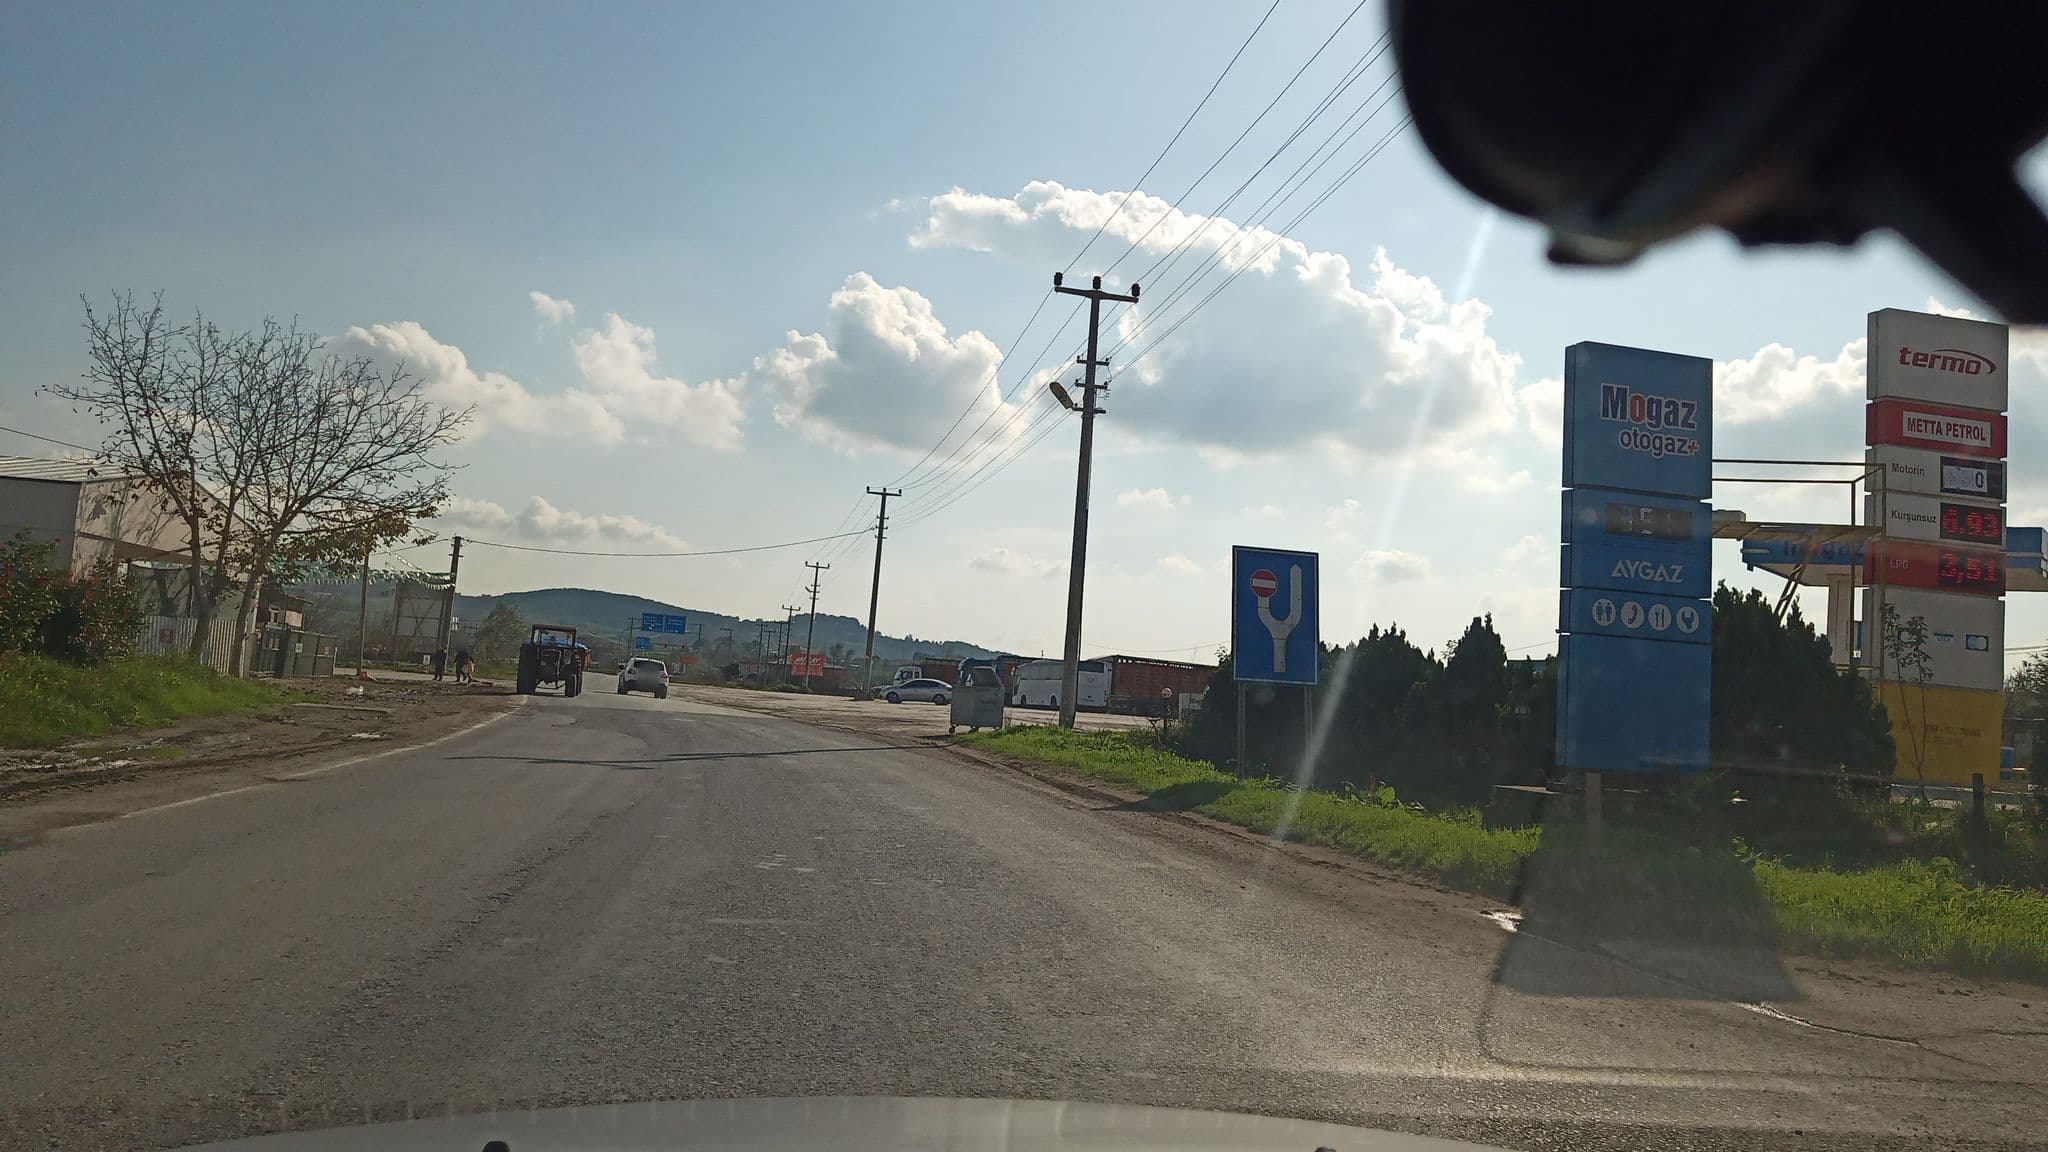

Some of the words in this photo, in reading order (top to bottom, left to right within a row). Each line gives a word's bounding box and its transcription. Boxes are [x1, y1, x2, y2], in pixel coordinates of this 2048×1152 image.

[1899, 347, 1982, 376] termo
[1601, 383, 1697, 429] Mogaz
[1906, 416, 1943, 435] METTA
[1945, 423, 1986, 441] PETROL
[1892, 462, 1925, 476] Motorin
[1891, 510, 1937, 524] Kurşunsuz
[1611, 559, 1684, 584] AYGAZ
[1888, 560, 1909, 572] LPG
